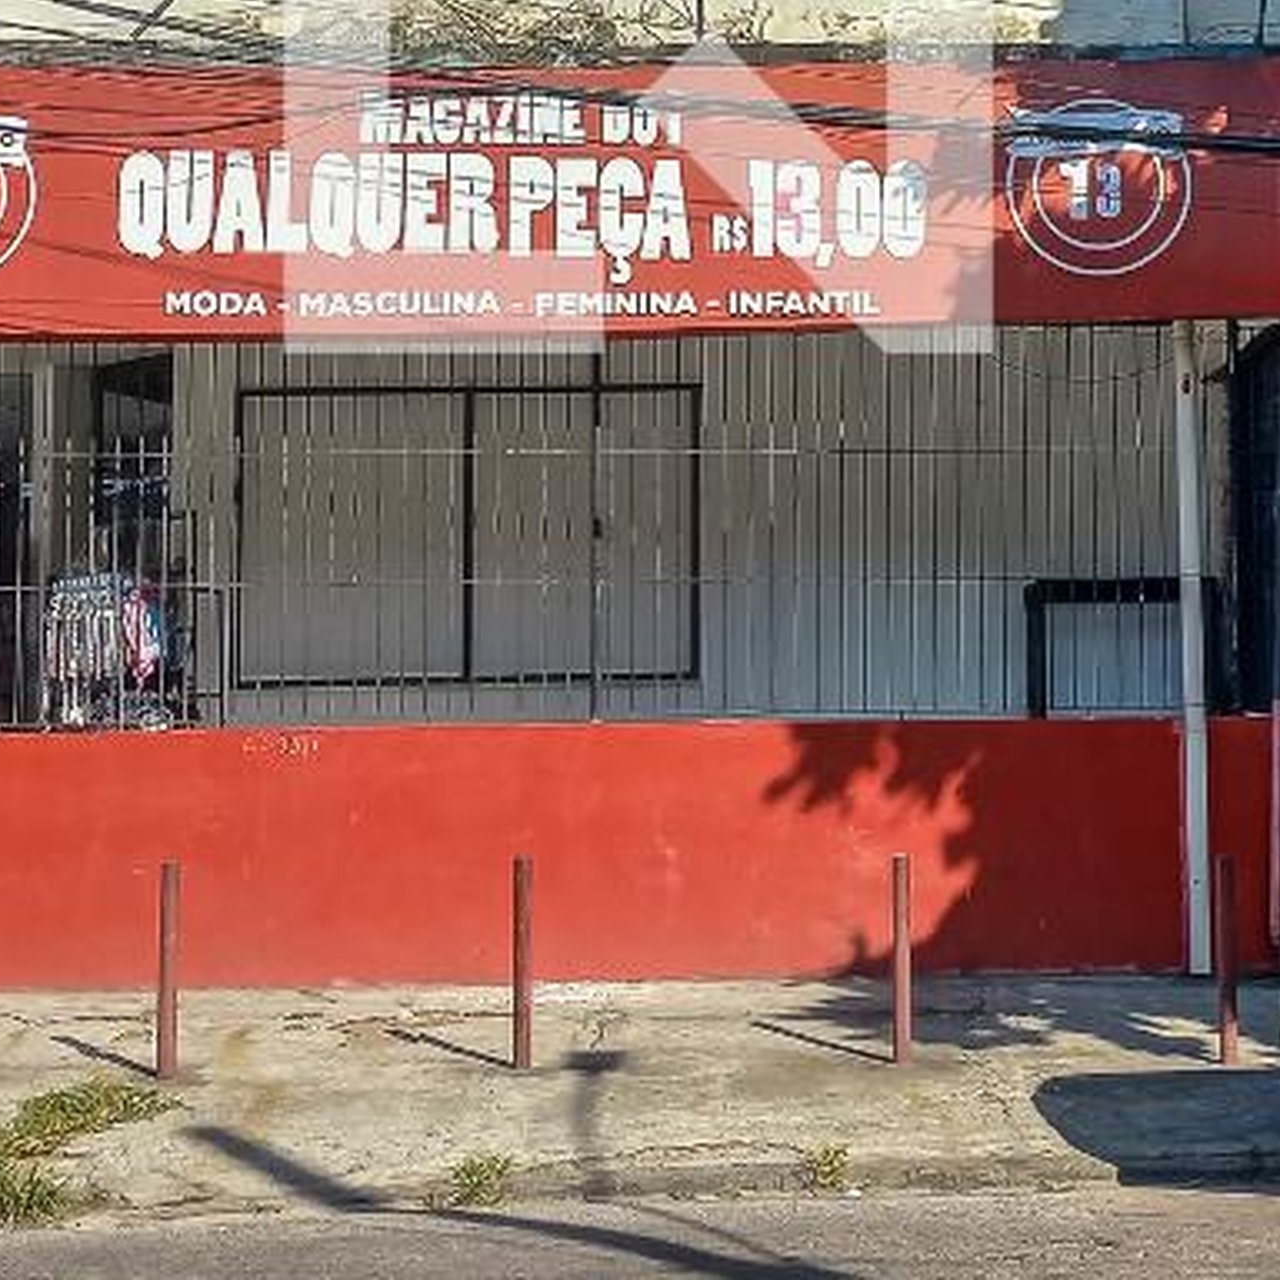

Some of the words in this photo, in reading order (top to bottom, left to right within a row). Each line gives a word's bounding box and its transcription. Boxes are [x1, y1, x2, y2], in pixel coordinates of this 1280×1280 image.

[360, 91, 585, 146] MAGAZINE
[118, 150, 499, 260] QUALQUER
[507, 156, 692, 284] PEÇA
[1058, 158, 1122, 220] 13
[164, 292, 266, 317] MODA
[299, 292, 501, 318] MASCULINA
[534, 292, 698, 316] FEMININA
[729, 292, 881, 316] INFANTIL
